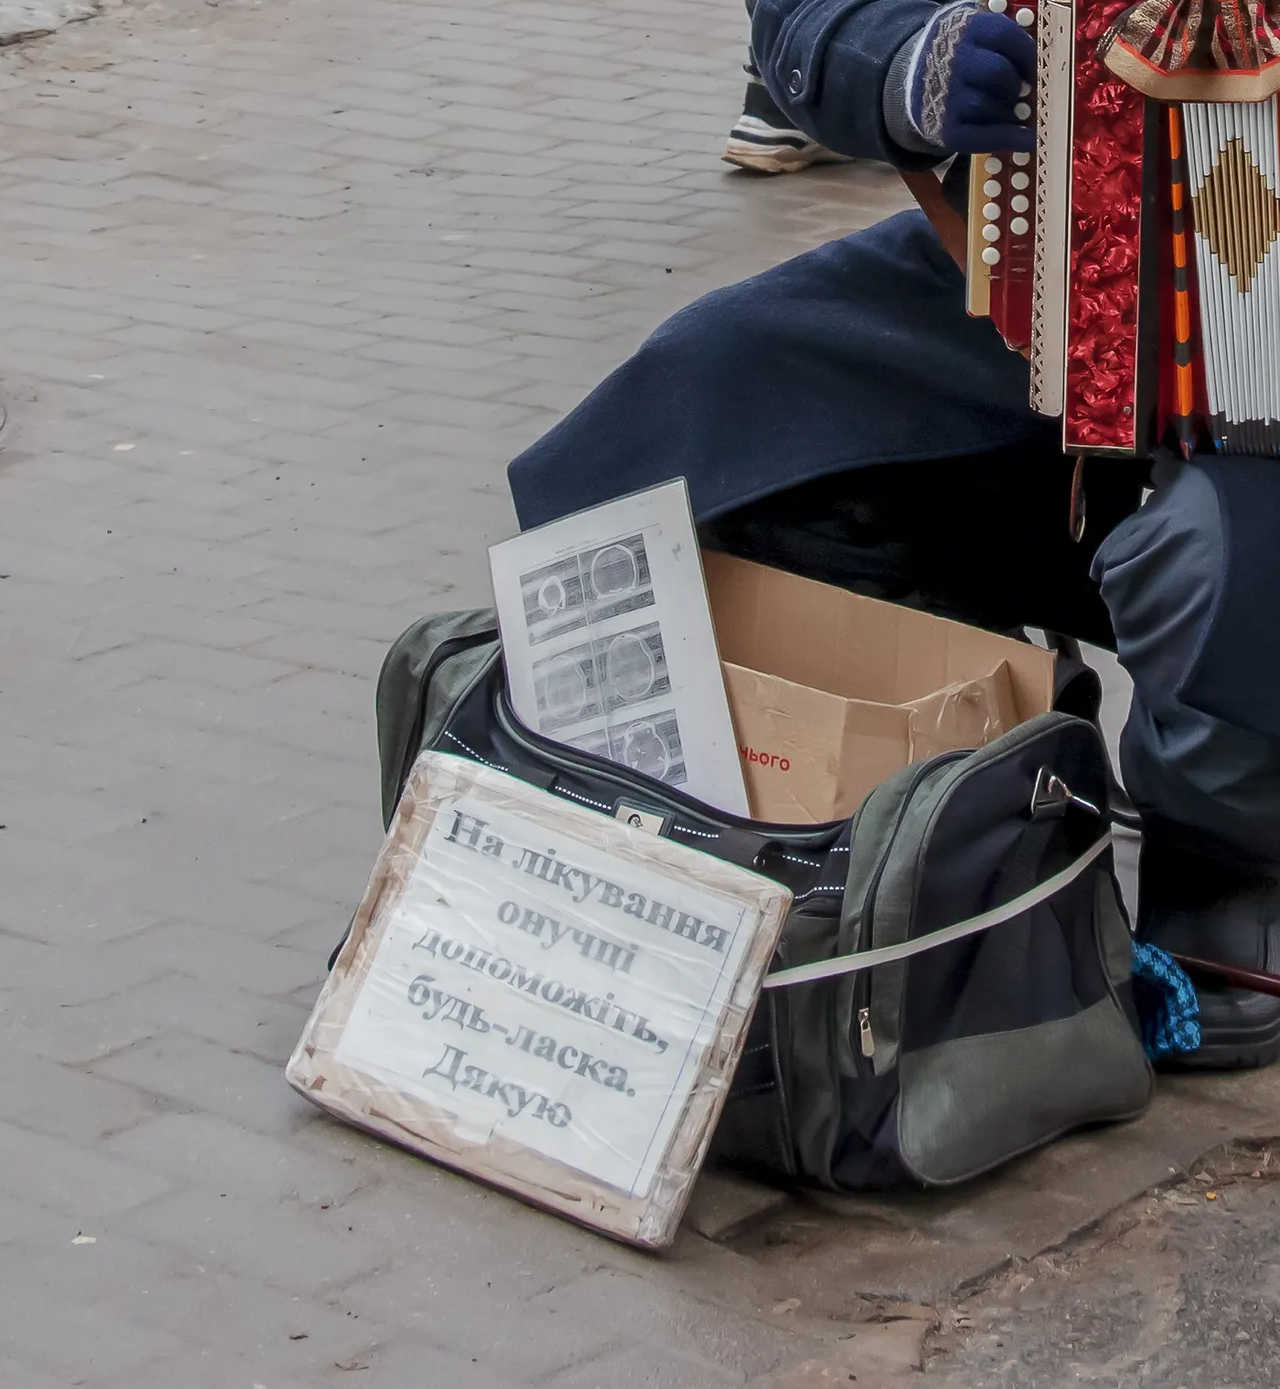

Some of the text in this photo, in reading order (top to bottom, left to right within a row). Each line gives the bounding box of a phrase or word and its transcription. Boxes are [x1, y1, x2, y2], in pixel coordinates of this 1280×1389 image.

[443, 809, 731, 954] На лікування
[407, 974, 637, 1098] будь-ласка.
[412, 926, 670, 1055] допоможіть,
[422, 1043, 573, 1129] Дякую
